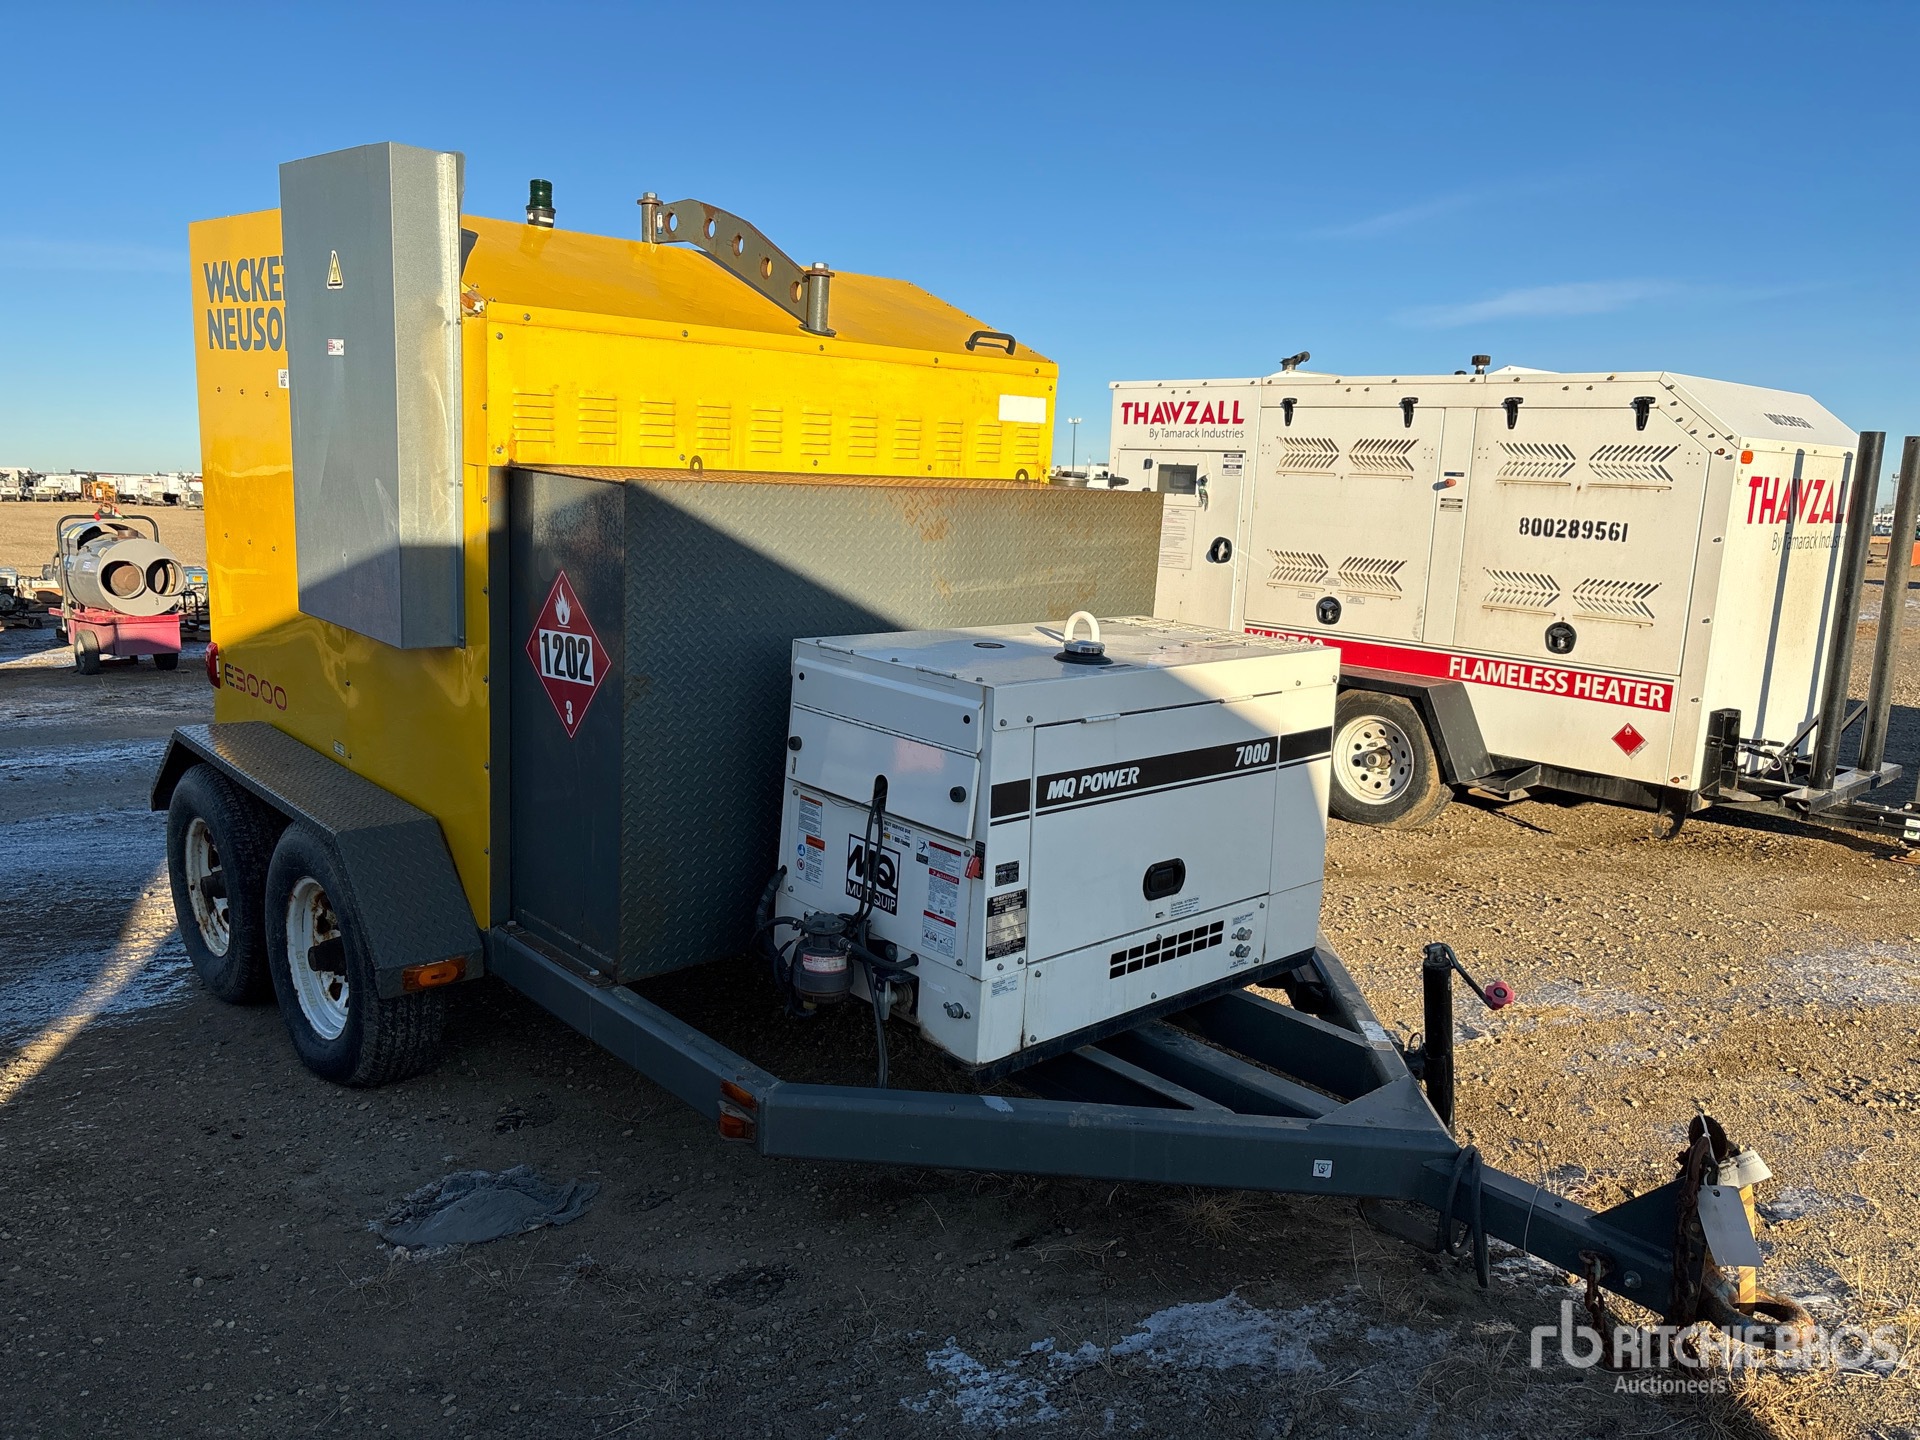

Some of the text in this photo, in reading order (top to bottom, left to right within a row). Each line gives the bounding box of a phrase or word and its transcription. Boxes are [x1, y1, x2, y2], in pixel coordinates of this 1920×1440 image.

[203, 255, 283, 303] WACKE
[207, 306, 287, 352] NEUSO
[1121, 400, 1245, 425] THAWZALL
[1149, 427, 1244, 440] By Tamarack Industries
[1747, 476, 1854, 525] THAWZAL
[1518, 516, 1628, 543] 800289561
[1771, 531, 1783, 556] By
[1784, 530, 1819, 550] Tamarack
[541, 631, 594, 684] 1202
[224, 662, 288, 712] E3000
[1448, 656, 1667, 709] FLAMELESS HEATER
[565, 700, 574, 726] 3
[1234, 741, 1271, 768] 7000
[1046, 766, 1141, 800] MQ POWER
[846, 881, 896, 912] MUTQUIP
